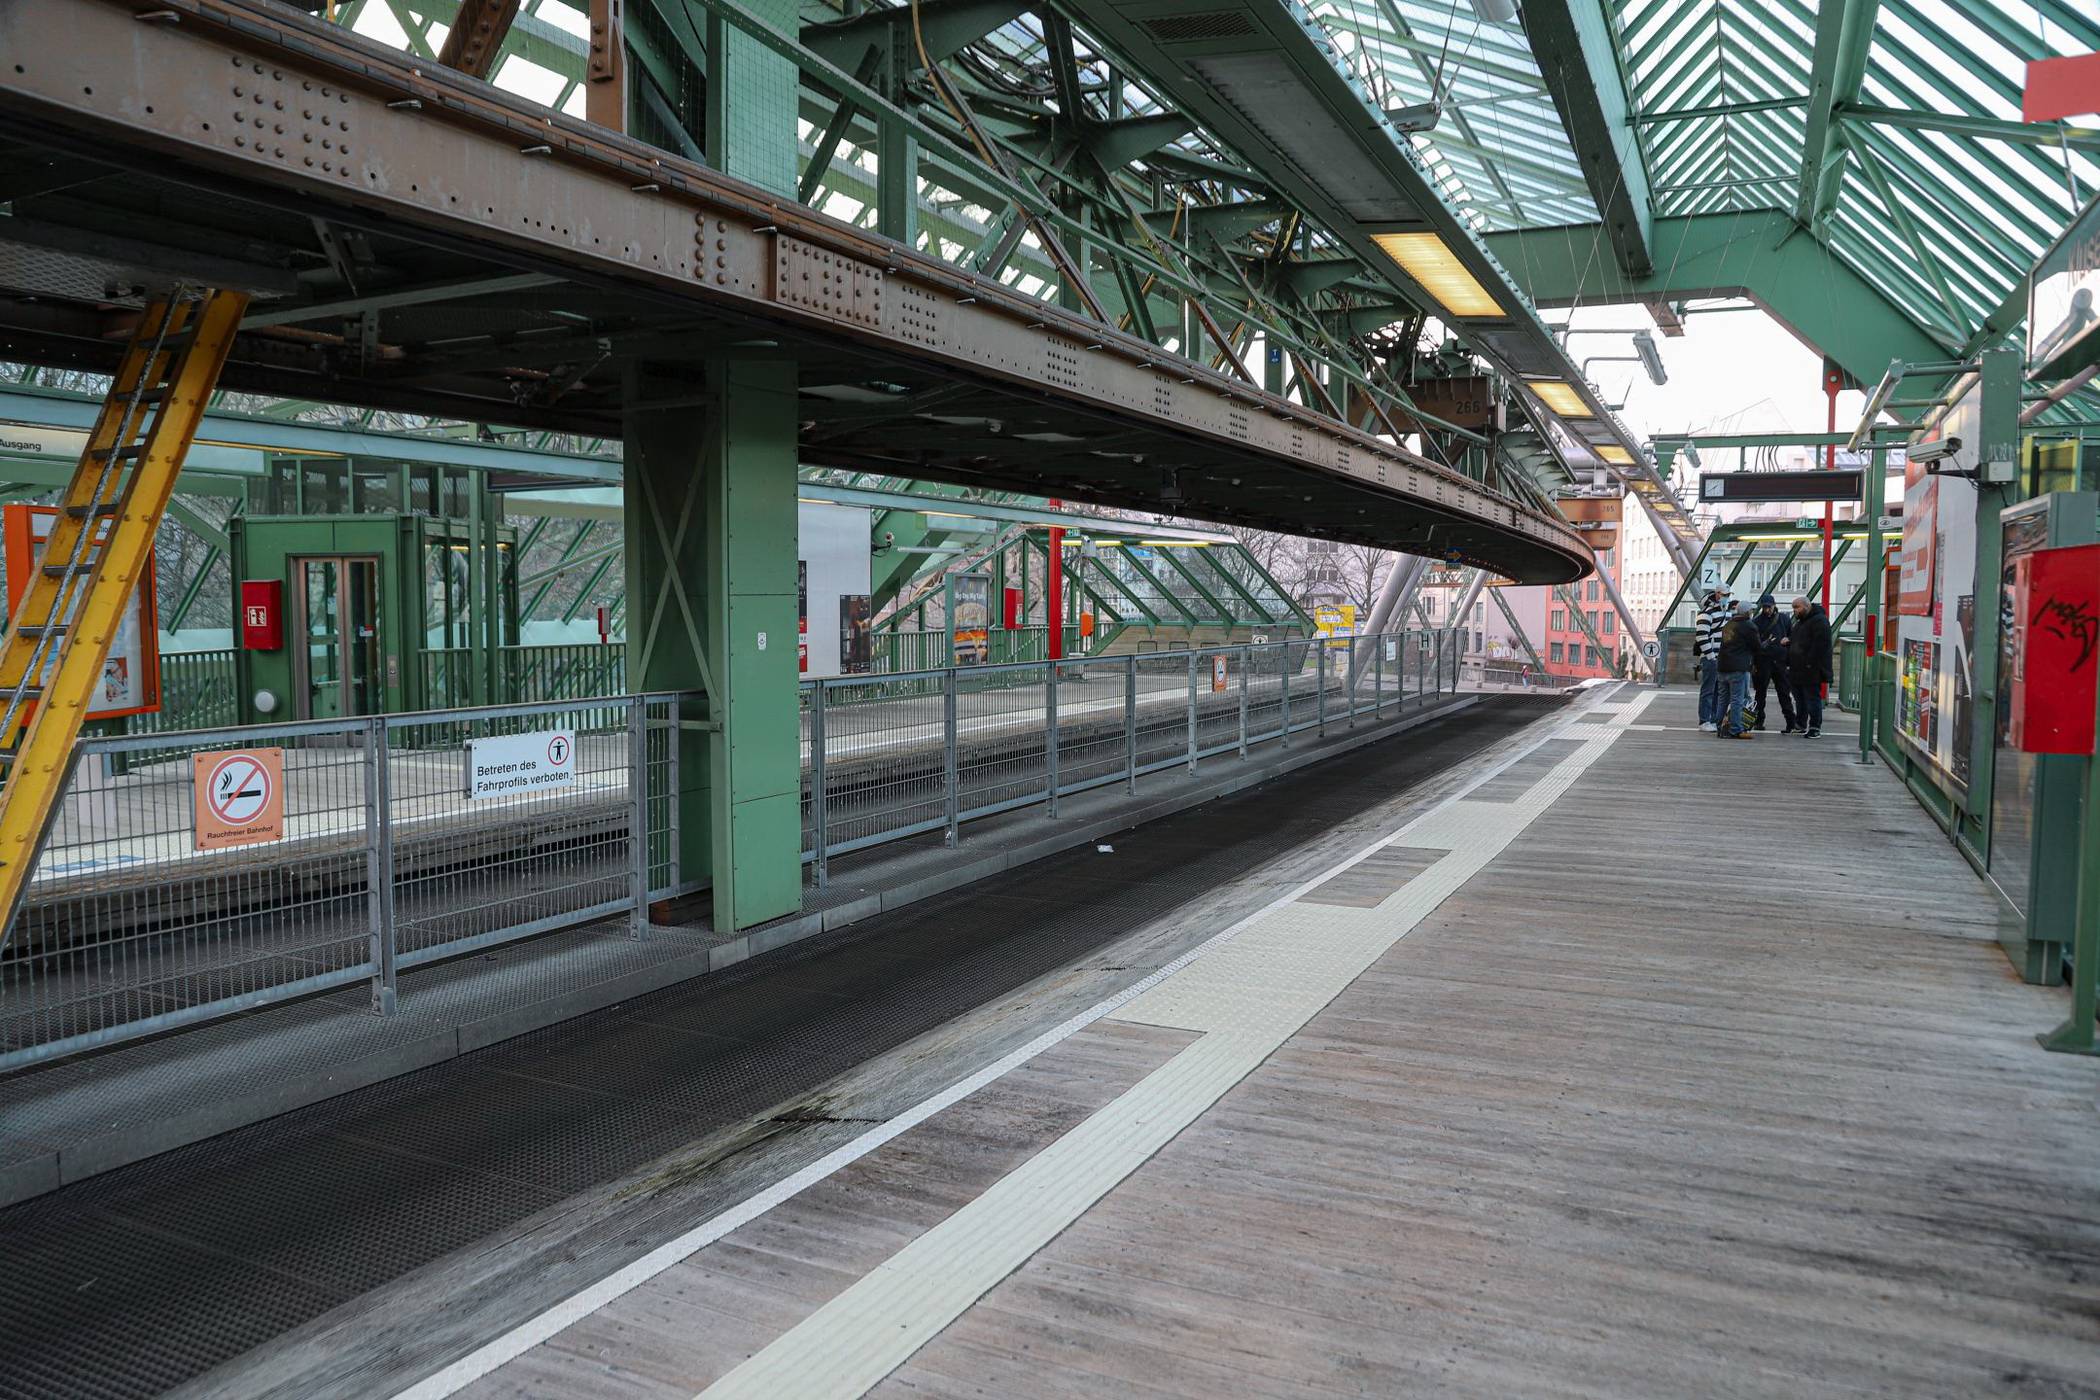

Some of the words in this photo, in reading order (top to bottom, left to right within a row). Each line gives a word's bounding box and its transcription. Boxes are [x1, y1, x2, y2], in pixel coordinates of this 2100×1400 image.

[1456, 400, 1480, 415] 266
[0, 438, 42, 451] Ausgang
[1704, 569, 1714, 583] Z
[477, 764, 517, 777] Betreten
[519, 760, 537, 771] des
[477, 777, 528, 793] Fahrprofils
[530, 771, 569, 785] verboten
[207, 830, 245, 839] Rauchfreier
[247, 825, 274, 835] Bahnhof
